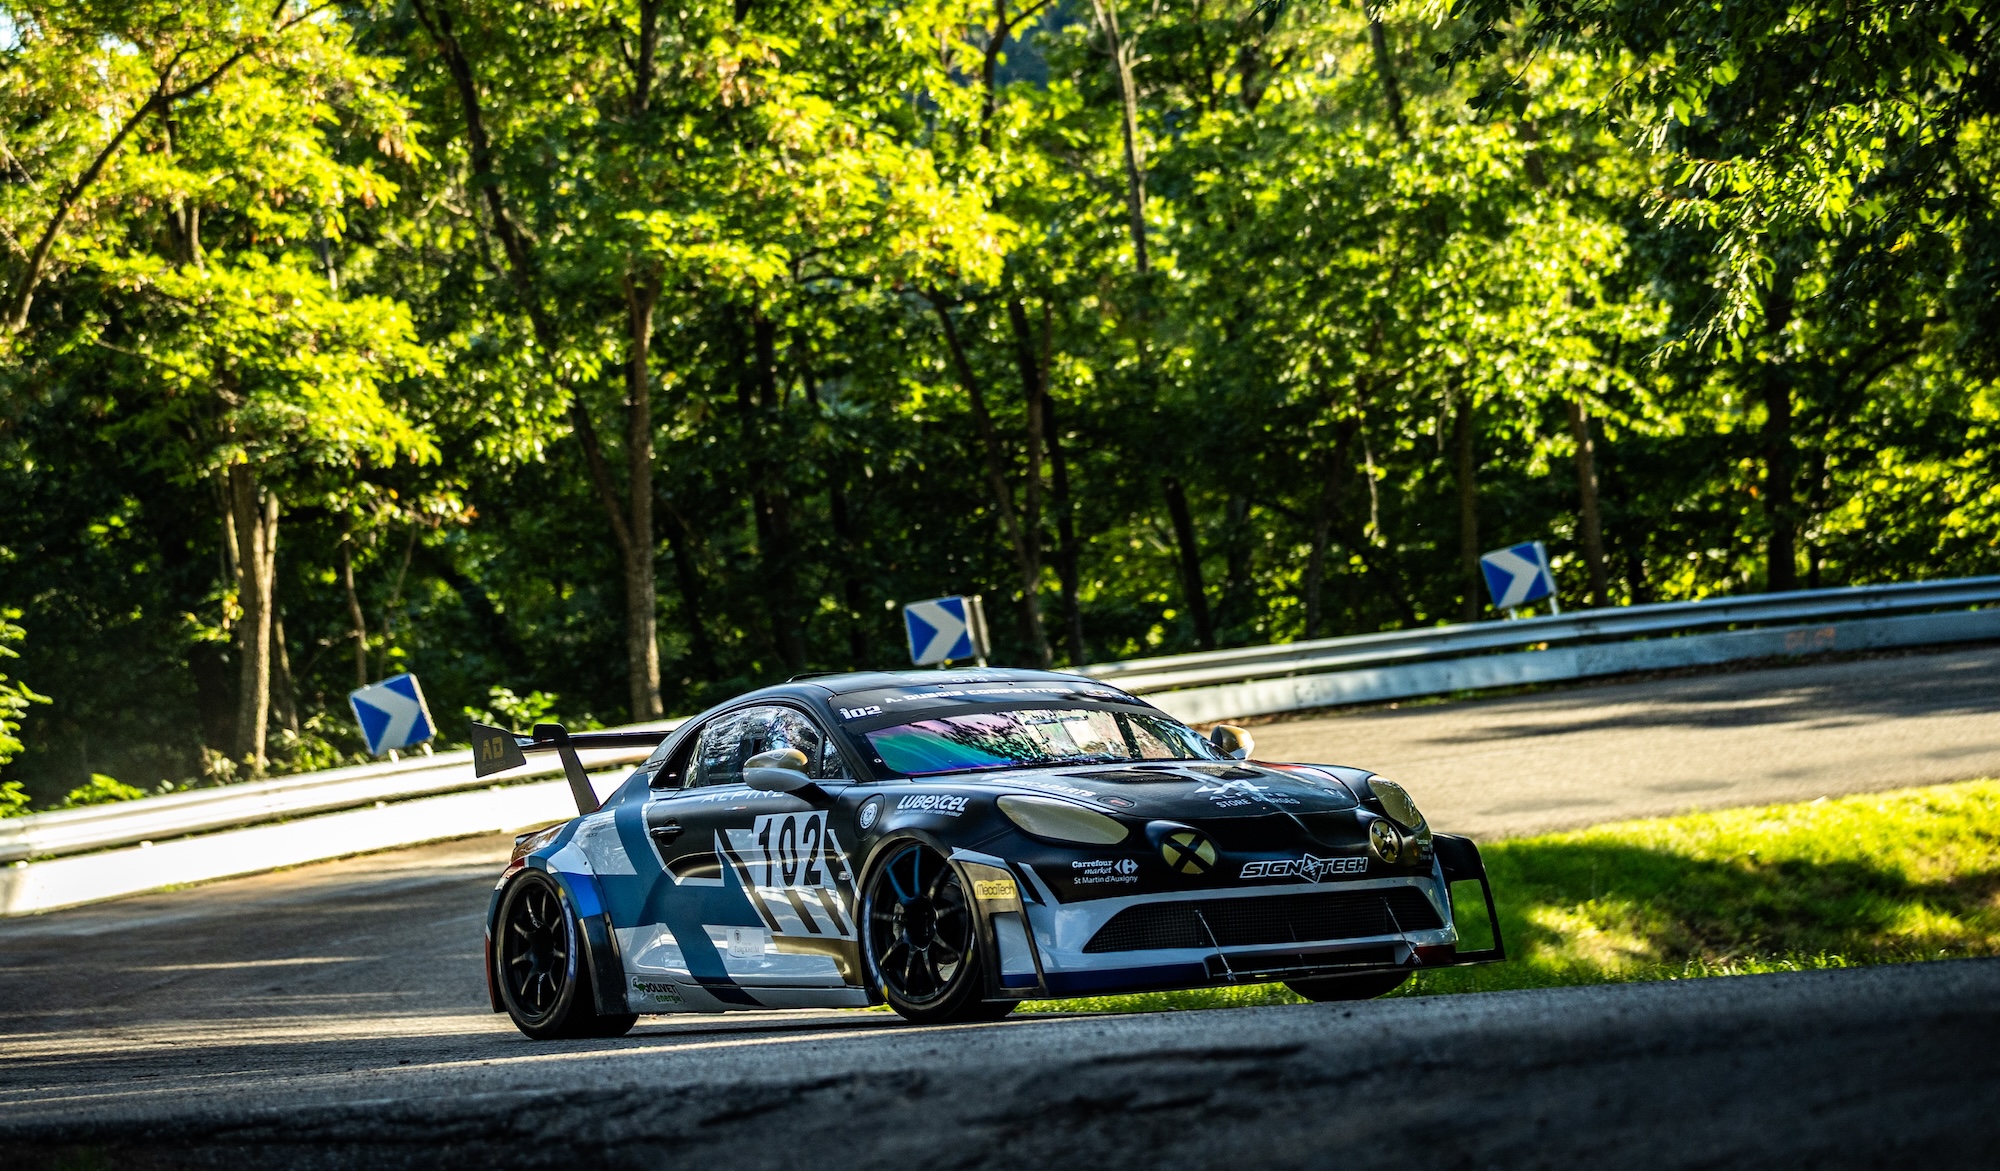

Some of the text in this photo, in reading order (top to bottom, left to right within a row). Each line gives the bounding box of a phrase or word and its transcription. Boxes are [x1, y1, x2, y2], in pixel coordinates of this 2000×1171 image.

[902, 691, 965, 701] DUBOIS
[966, 688, 1075, 696] COMPETITION
[839, 705, 882, 719] 102
[481, 736, 503, 761] AD
[1216, 799, 1252, 808] STORE
[758, 814, 822, 888] 102
[1071, 859, 1113, 868] Carrefour
[1073, 874, 1138, 884] St Martin d'Auxigny
[645, 982, 678, 995] JOLIVET
